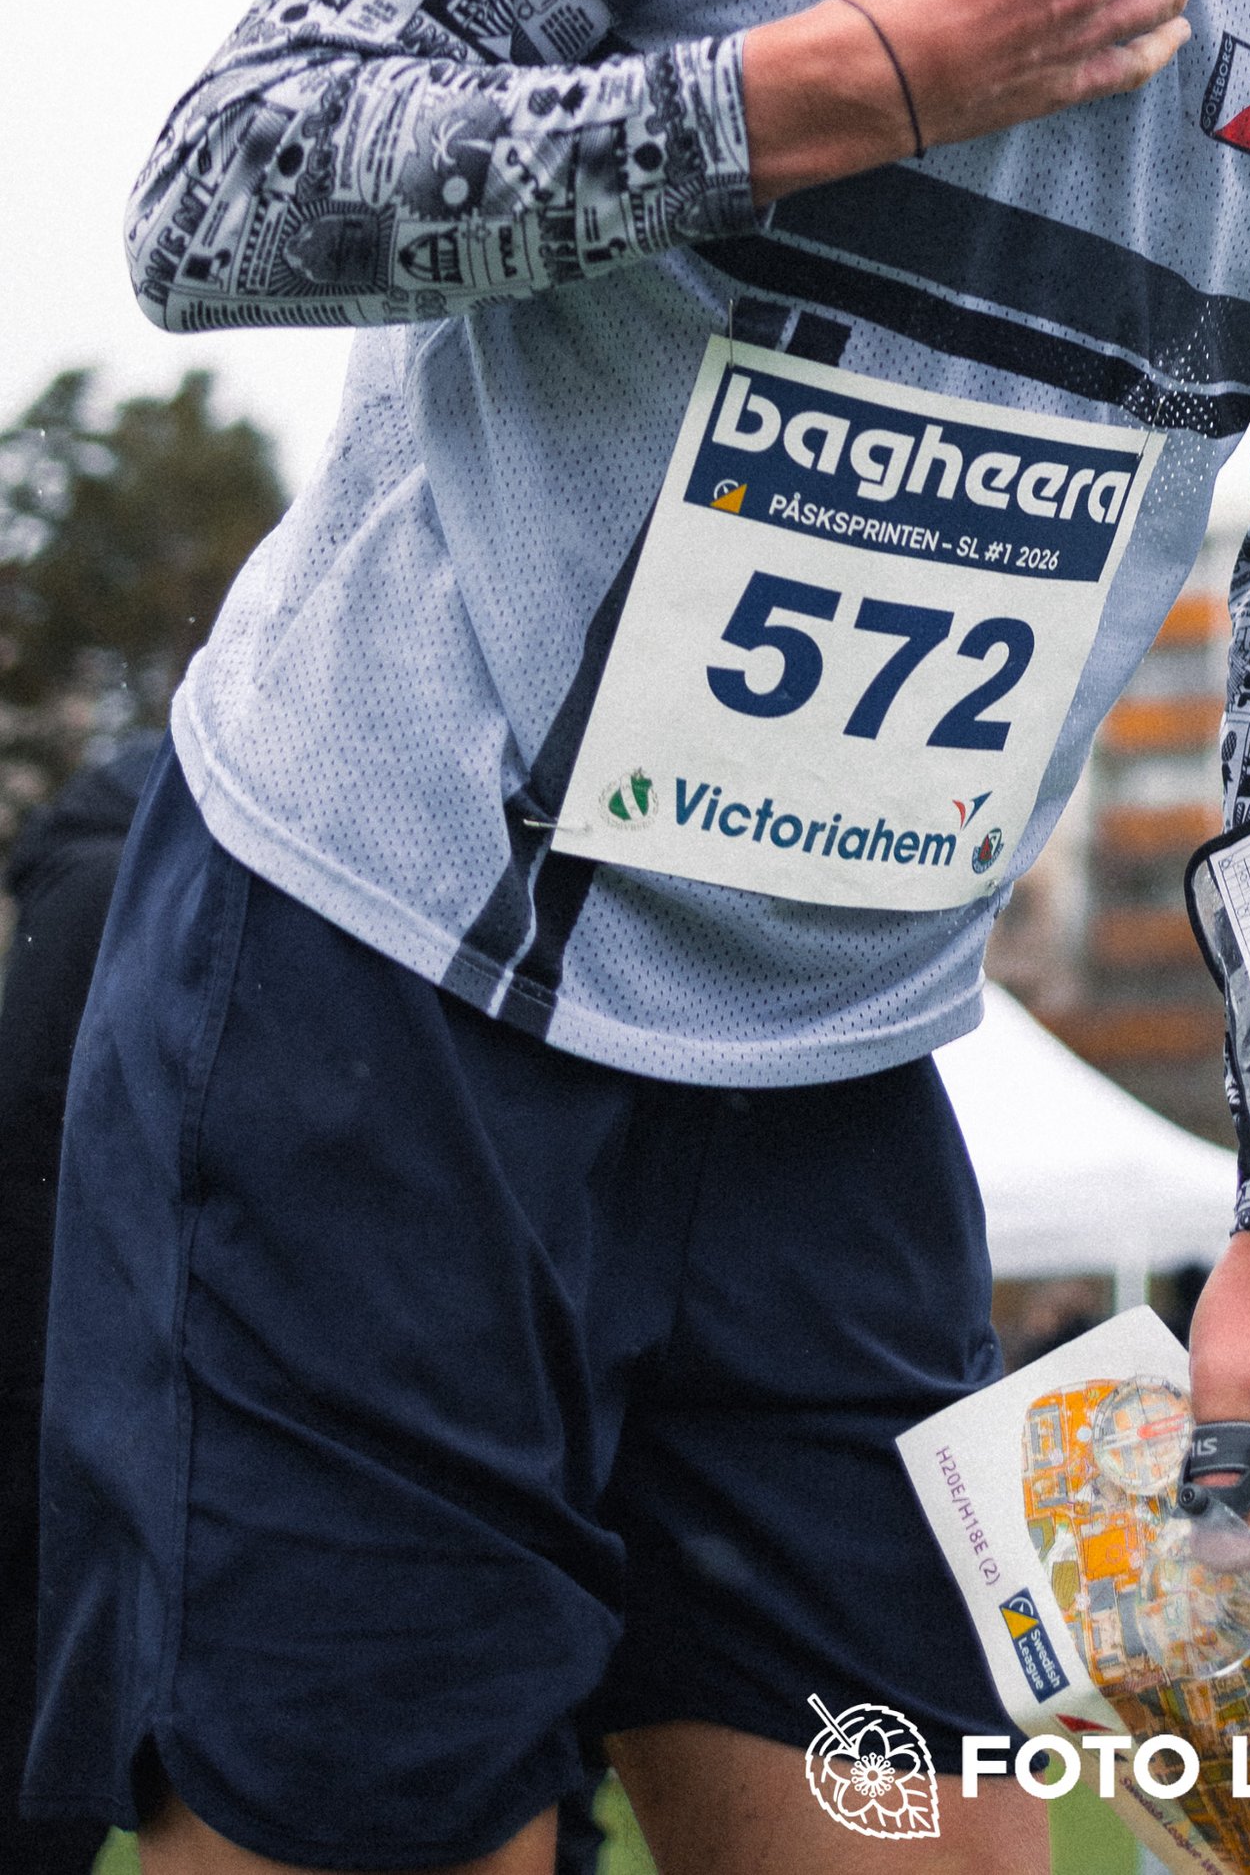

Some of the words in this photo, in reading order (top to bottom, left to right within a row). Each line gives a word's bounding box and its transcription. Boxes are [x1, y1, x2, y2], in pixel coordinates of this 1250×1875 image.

[712, 373, 1134, 524] bagheera
[768, 492, 939, 553] PÅSKSPRINTEN
[956, 536, 980, 560] SL
[984, 541, 1012, 566] #1
[1016, 547, 1059, 571] 2026
[706, 570, 1035, 751] 572
[674, 777, 956, 867] Victoriahem
[935, 1445, 989, 1556] H20E/H18E
[977, 1556, 1002, 1586] (2)
[1016, 1637, 1047, 1691] League
[1029, 1628, 1063, 1689] Swedish
